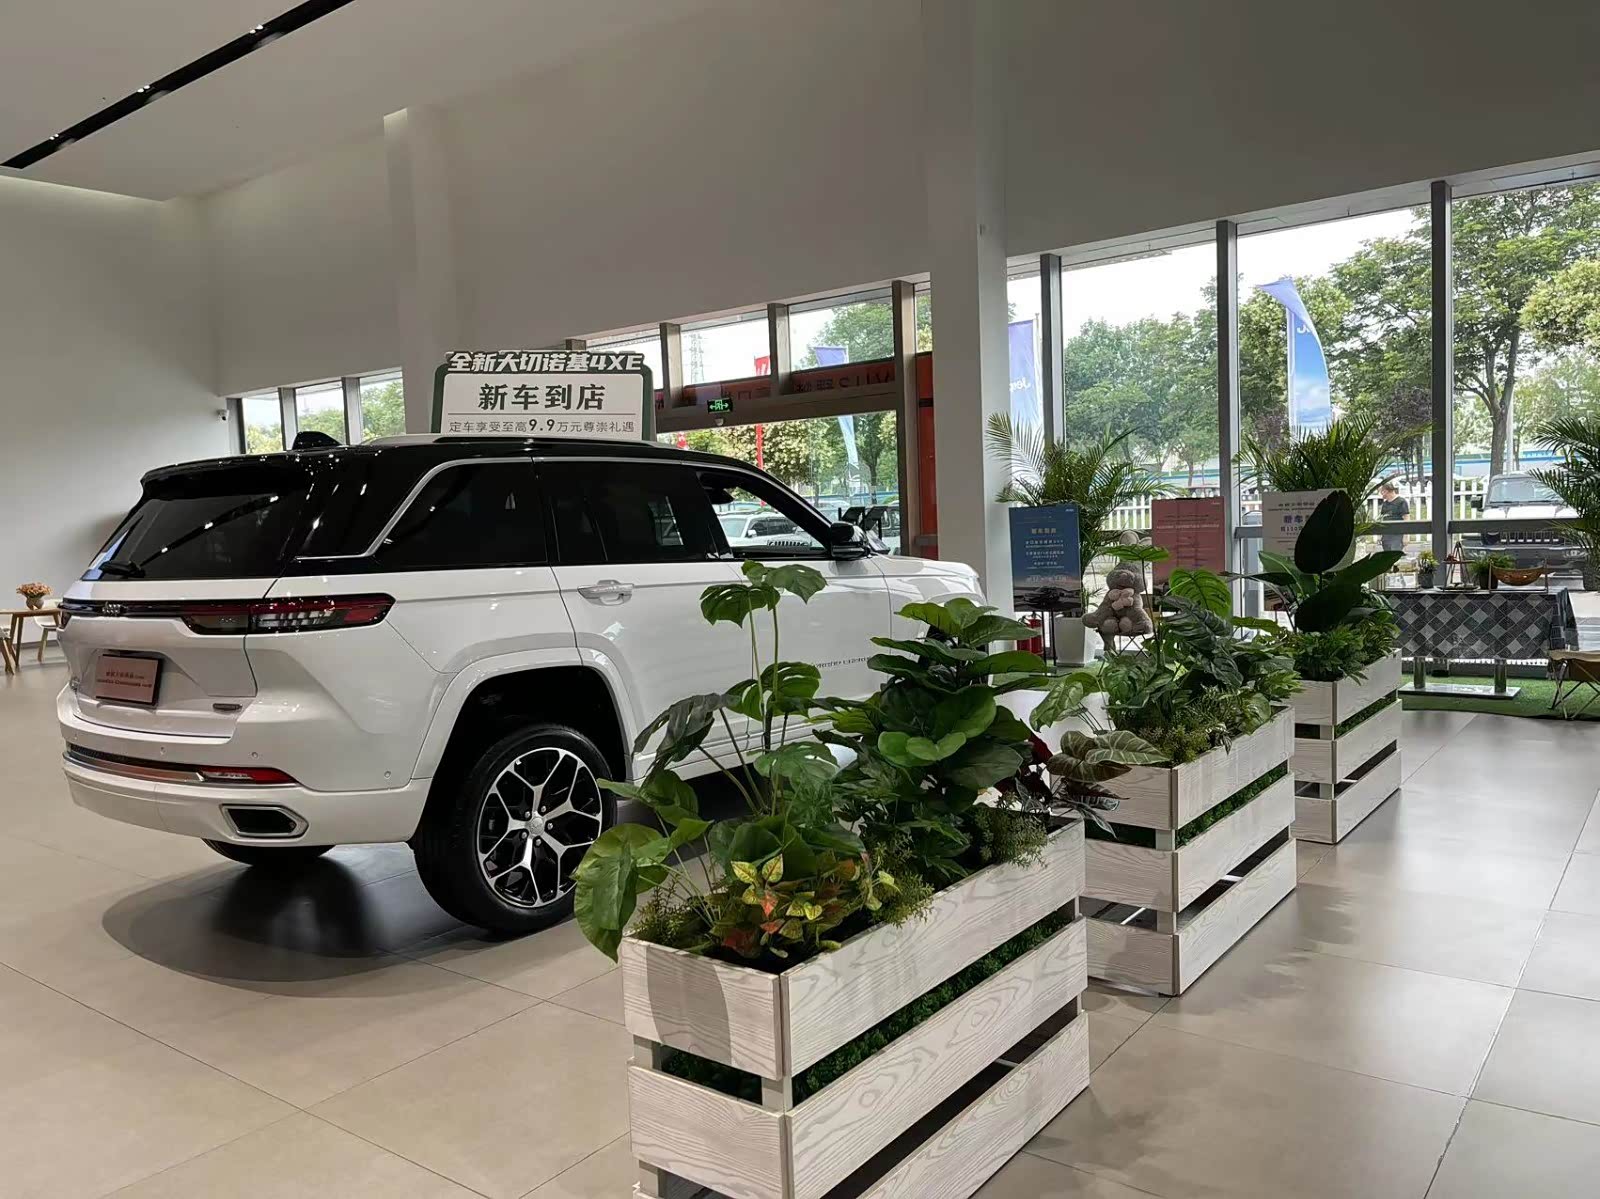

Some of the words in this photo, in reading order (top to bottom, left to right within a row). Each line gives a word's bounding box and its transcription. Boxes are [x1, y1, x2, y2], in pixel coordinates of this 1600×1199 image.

[447, 352, 643, 372] 全新大切诺基4XE
[478, 383, 605, 410] 新车到店
[449, 419, 635, 433] 定车享受至高9.9万元尊崇礼遇
